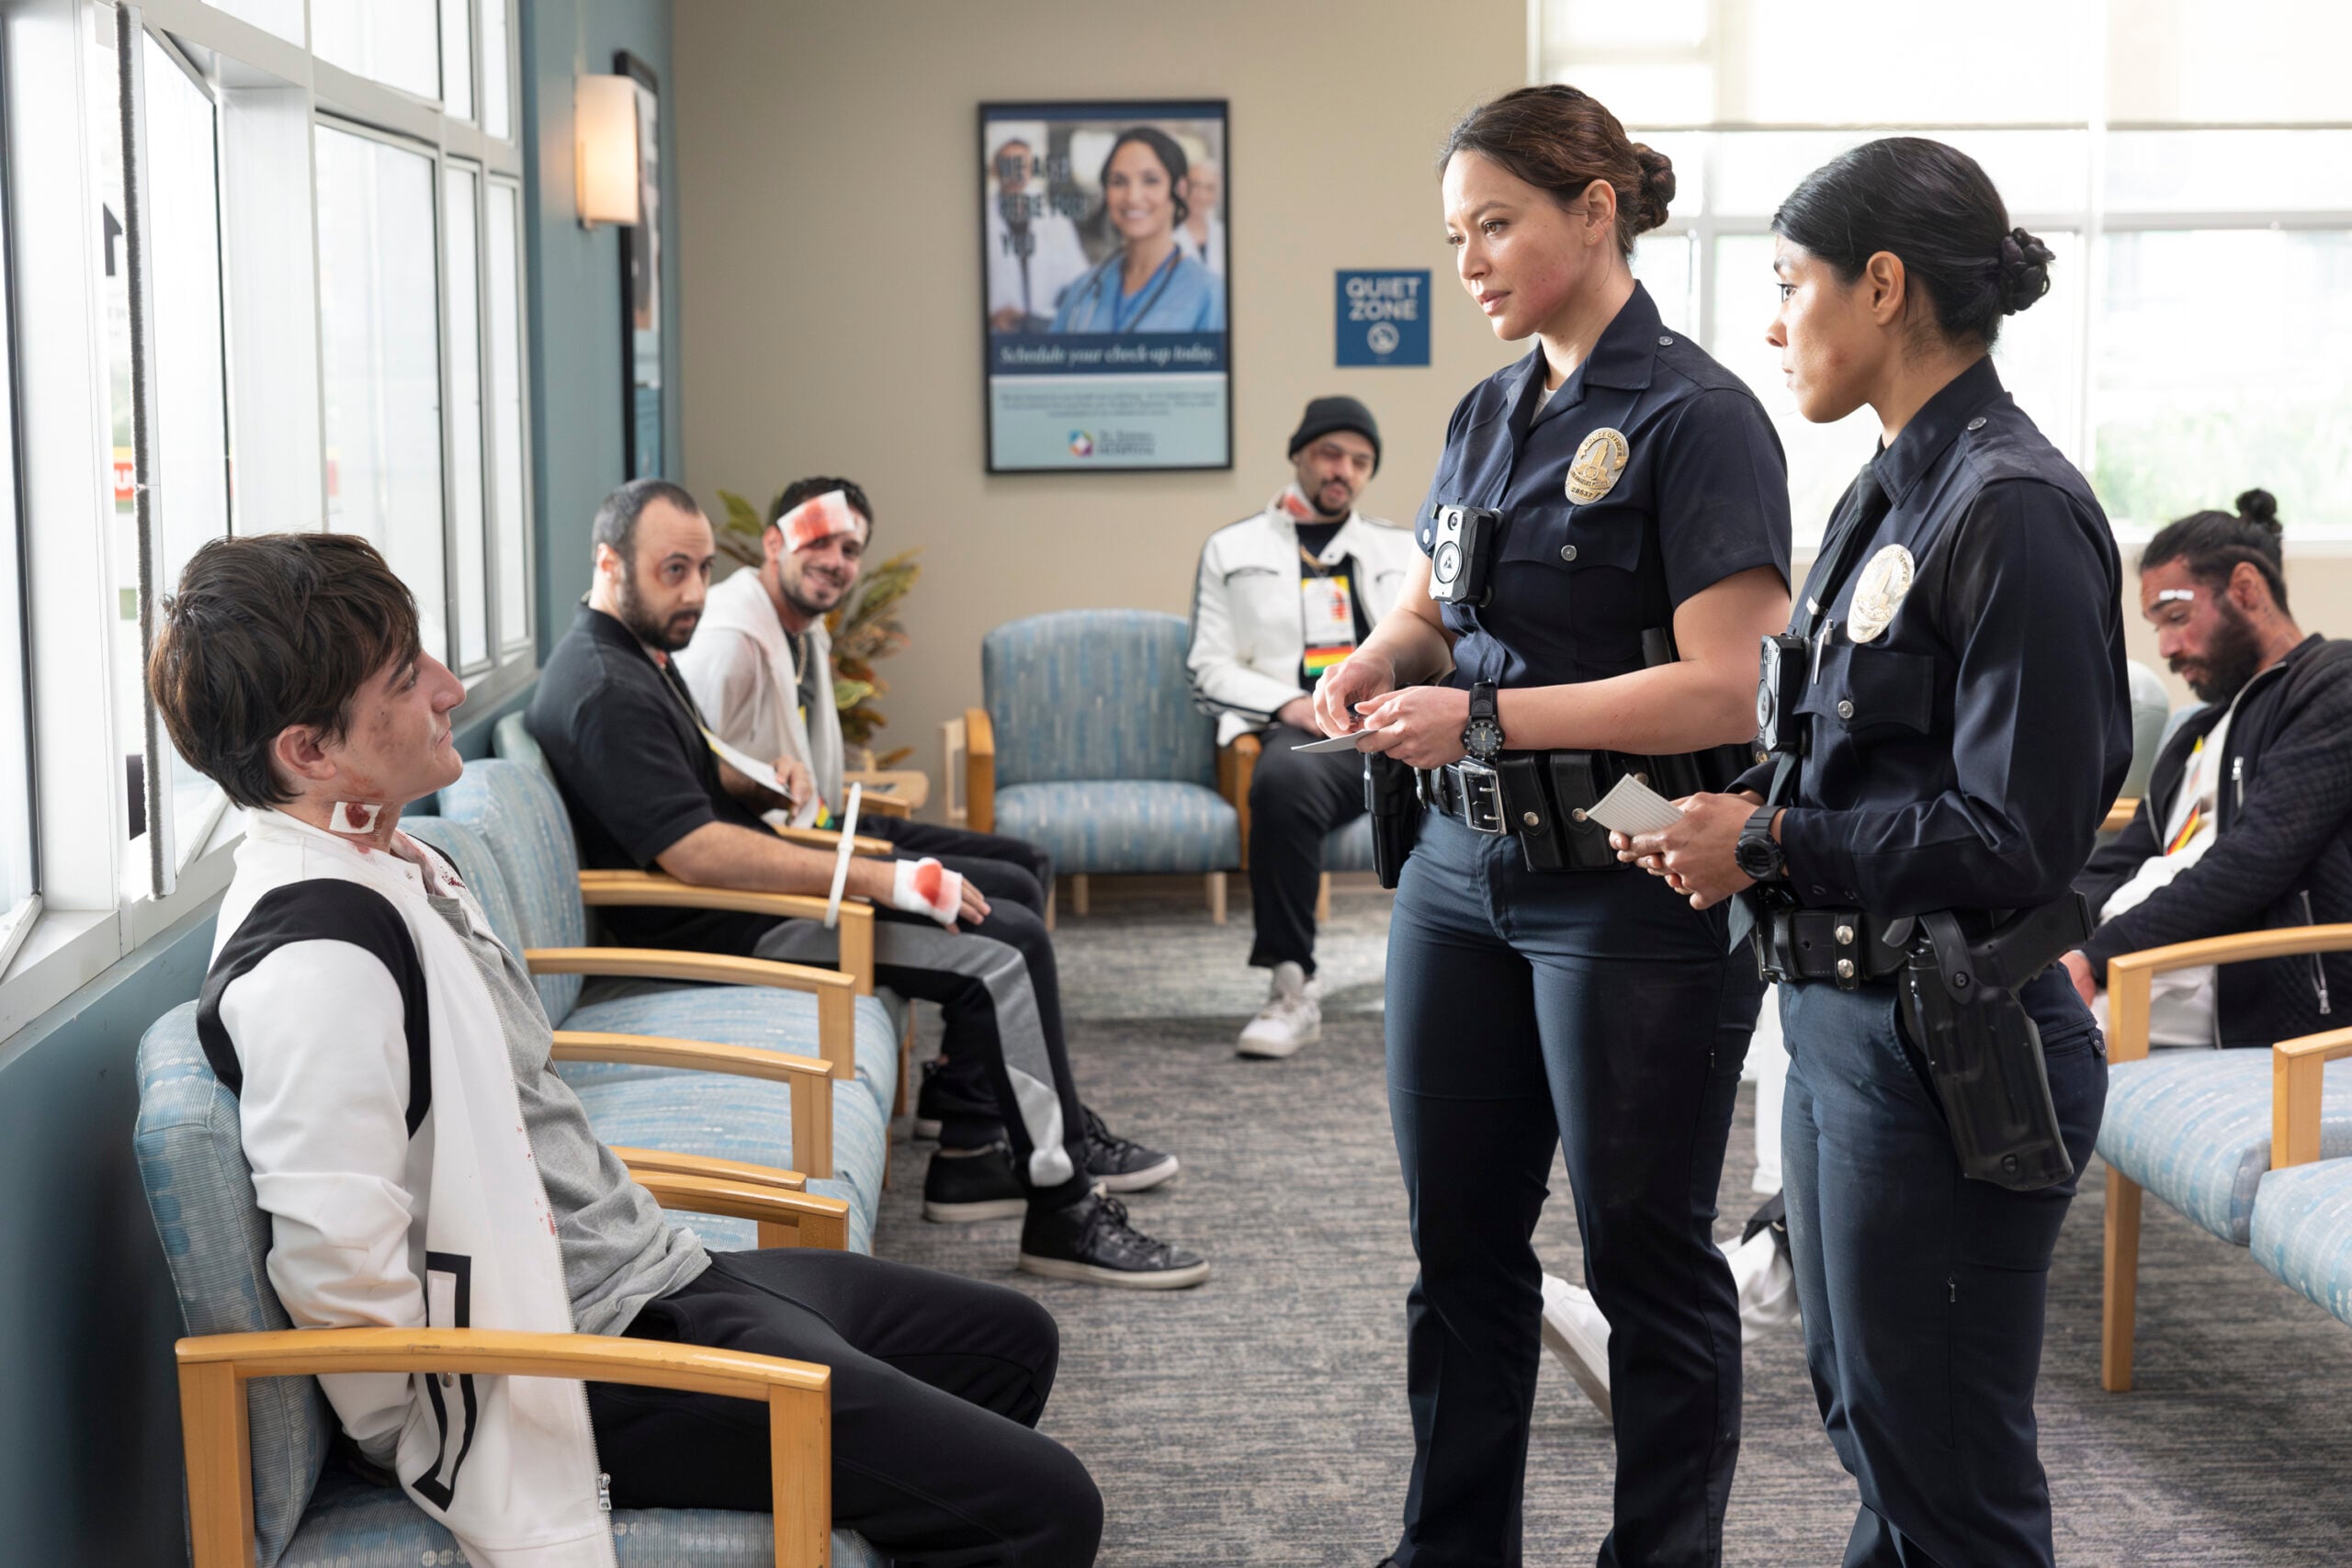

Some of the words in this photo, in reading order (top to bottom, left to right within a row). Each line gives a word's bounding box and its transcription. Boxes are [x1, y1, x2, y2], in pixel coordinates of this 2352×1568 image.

[1345, 276, 1422, 299] QUIET
[1348, 298, 1419, 321] ZONE
[1000, 344, 1065, 365] Schedule
[1068, 348, 1102, 367] your
[1585, 432, 1605, 447] POLICE
[1571, 487, 1593, 498] 28537
